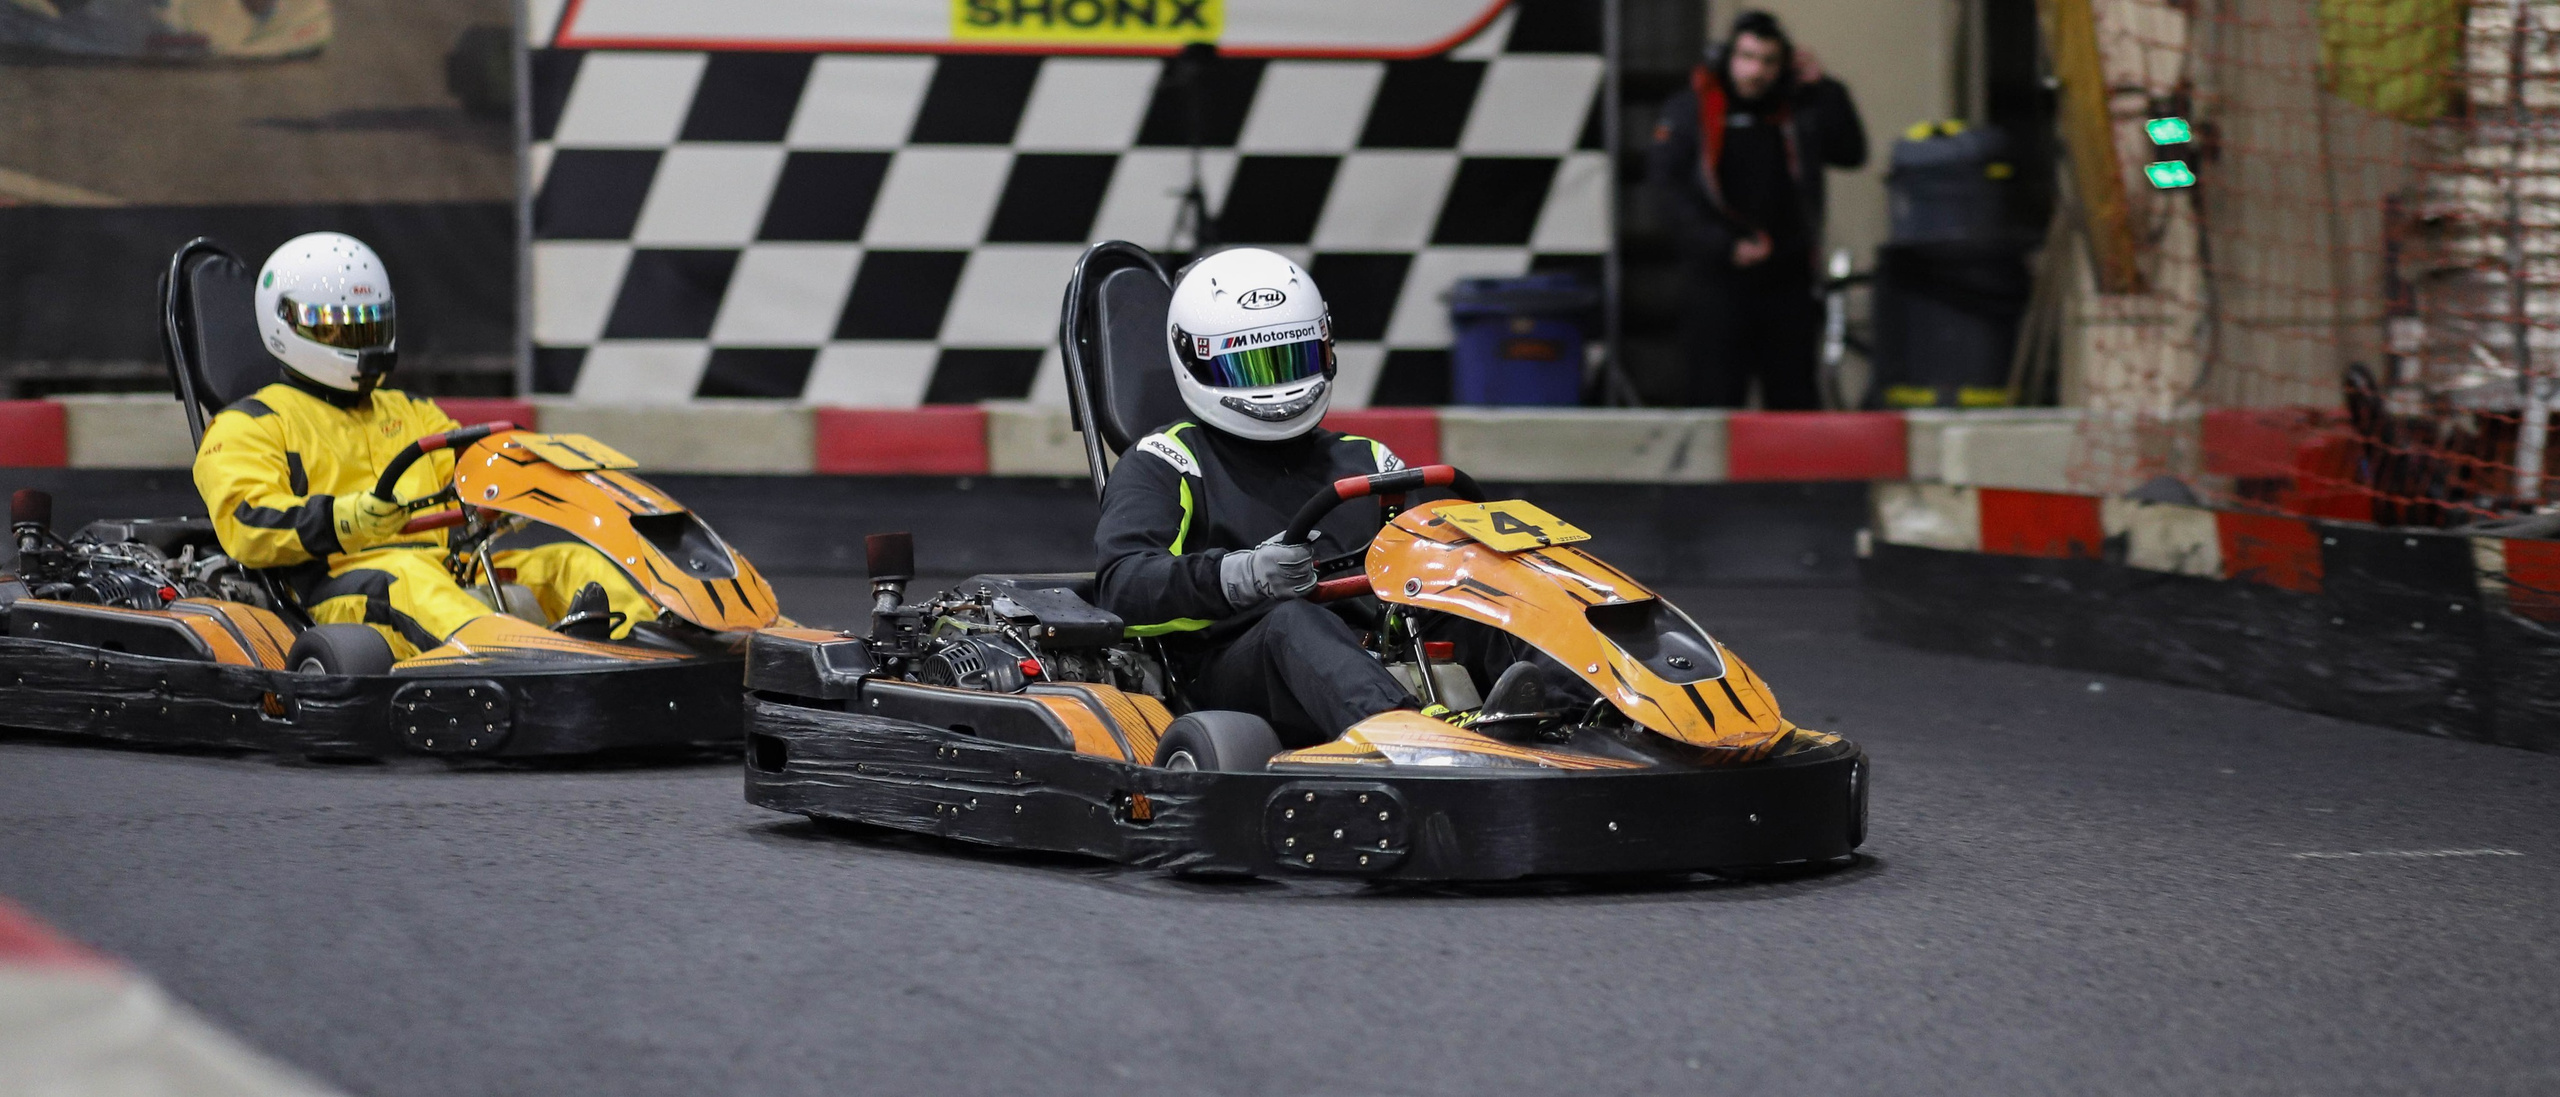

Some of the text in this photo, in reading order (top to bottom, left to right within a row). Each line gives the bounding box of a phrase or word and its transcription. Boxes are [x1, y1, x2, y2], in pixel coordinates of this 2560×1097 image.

[965, 0, 1208, 28] SHONX
[1242, 290, 1281, 306] Arai
[1250, 325, 1316, 345] Motorsport
[1490, 511, 1547, 537] 4
